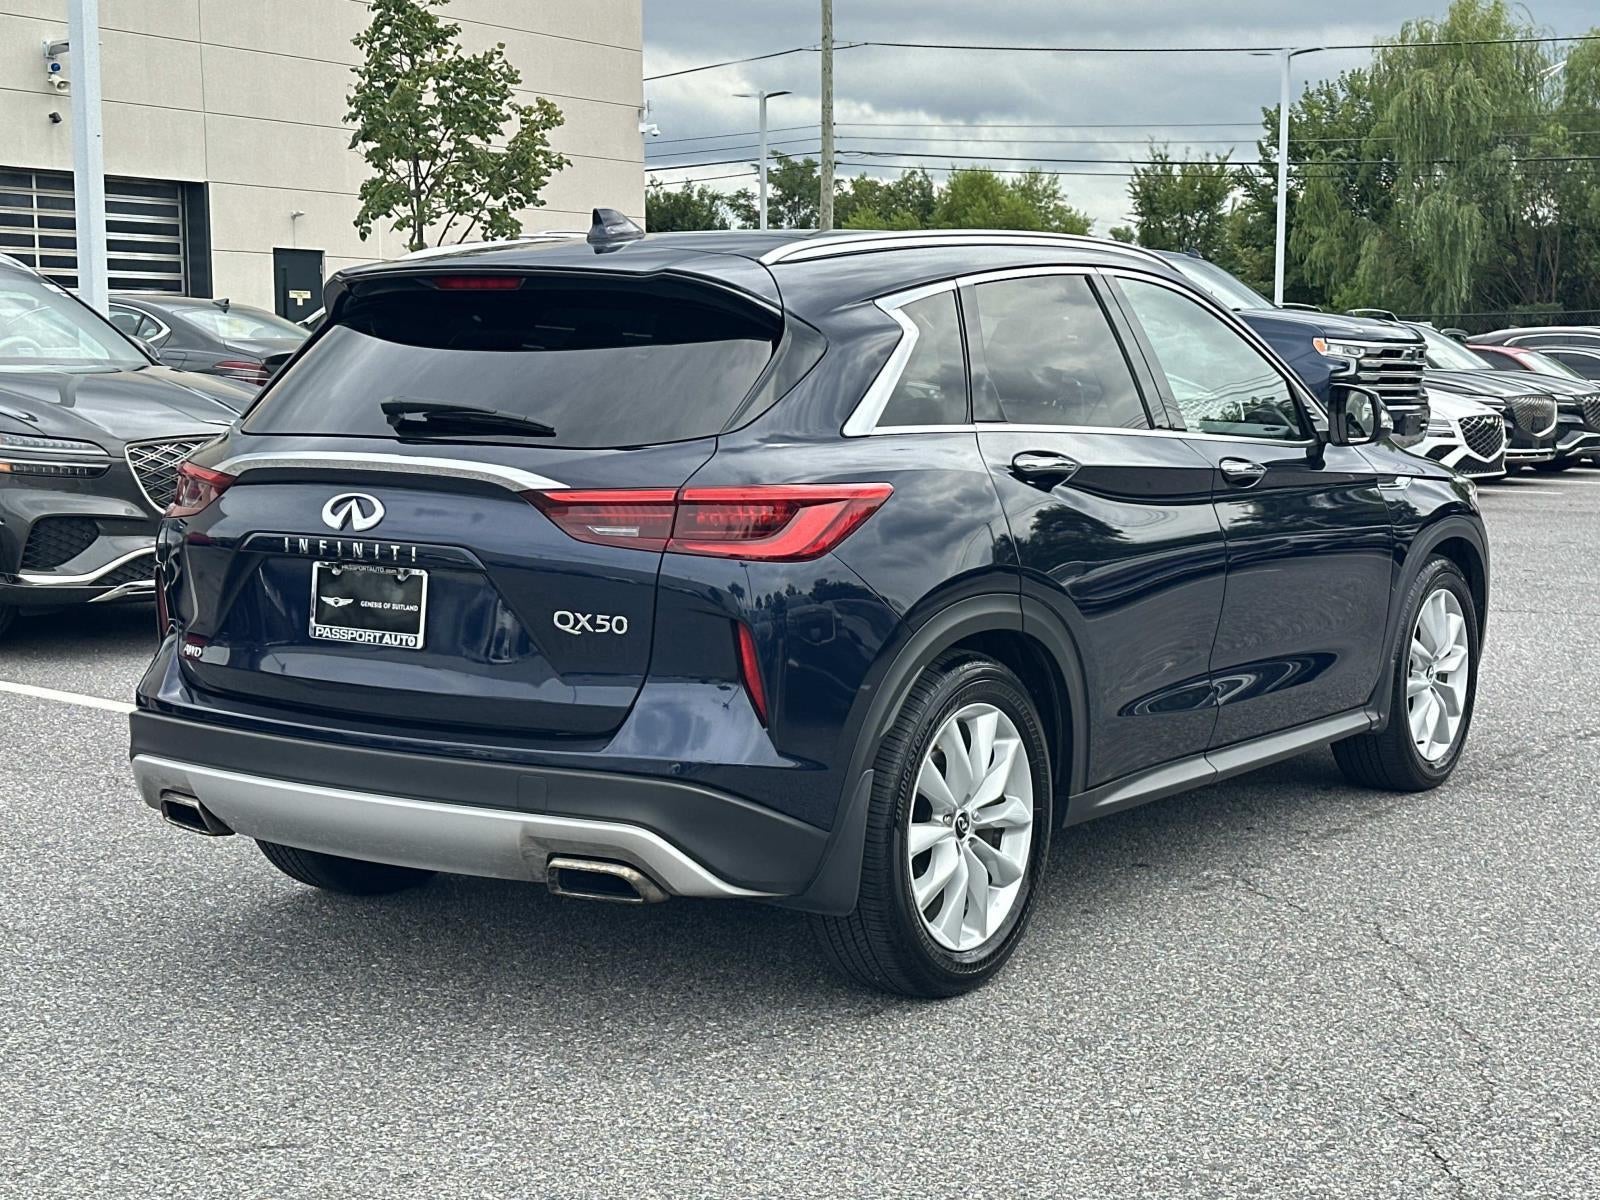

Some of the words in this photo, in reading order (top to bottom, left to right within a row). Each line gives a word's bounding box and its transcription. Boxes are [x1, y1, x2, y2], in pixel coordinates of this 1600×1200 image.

[284, 537, 417, 562] INFINITI
[360, 600, 383, 609] GENESIS
[391, 603, 419, 612] SUITLAND
[553, 610, 628, 635] QX50
[315, 626, 382, 645] PASSPORT
[382, 633, 416, 647] AUTO
[183, 643, 202, 658] AWD
